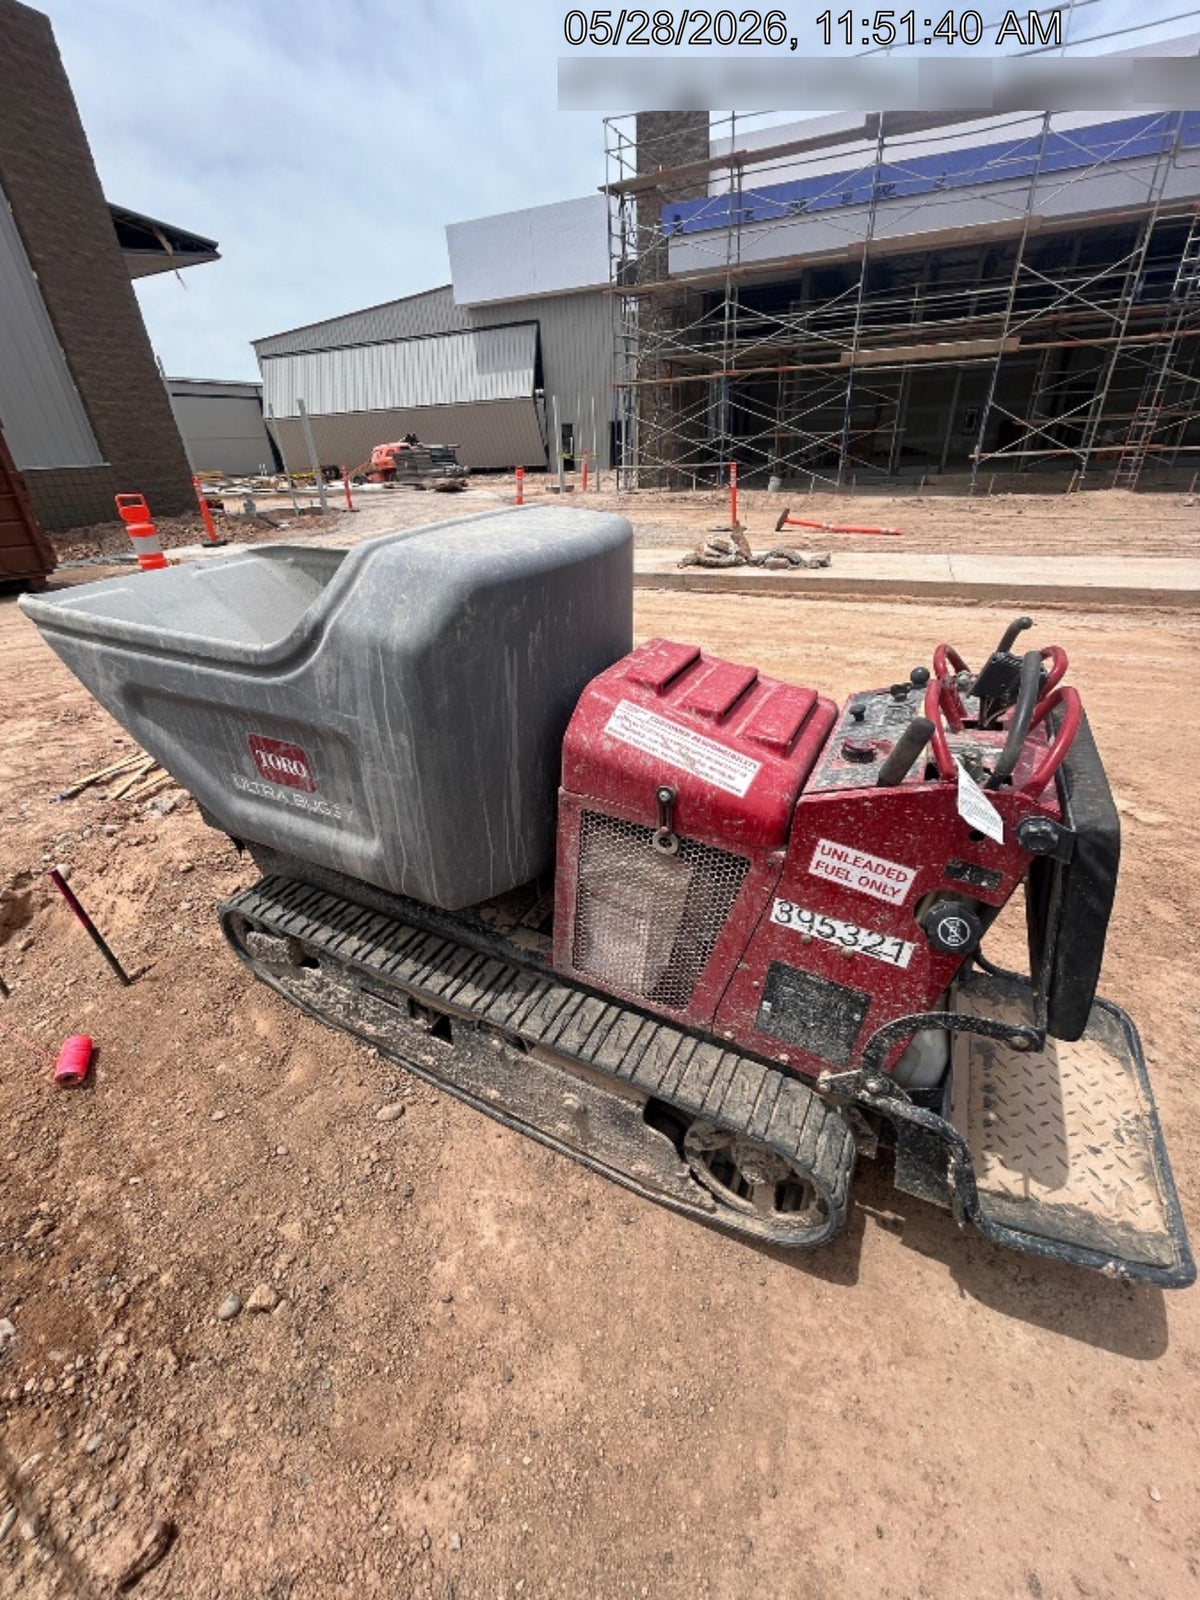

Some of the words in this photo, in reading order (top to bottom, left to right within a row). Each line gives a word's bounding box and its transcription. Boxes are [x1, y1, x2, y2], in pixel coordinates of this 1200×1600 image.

[255, 749, 308, 777] TORO
[815, 860, 852, 882] FUEL
[858, 875, 902, 898] ONLY
[820, 844, 908, 884] UNLEADED
[774, 900, 906, 963] 395321
